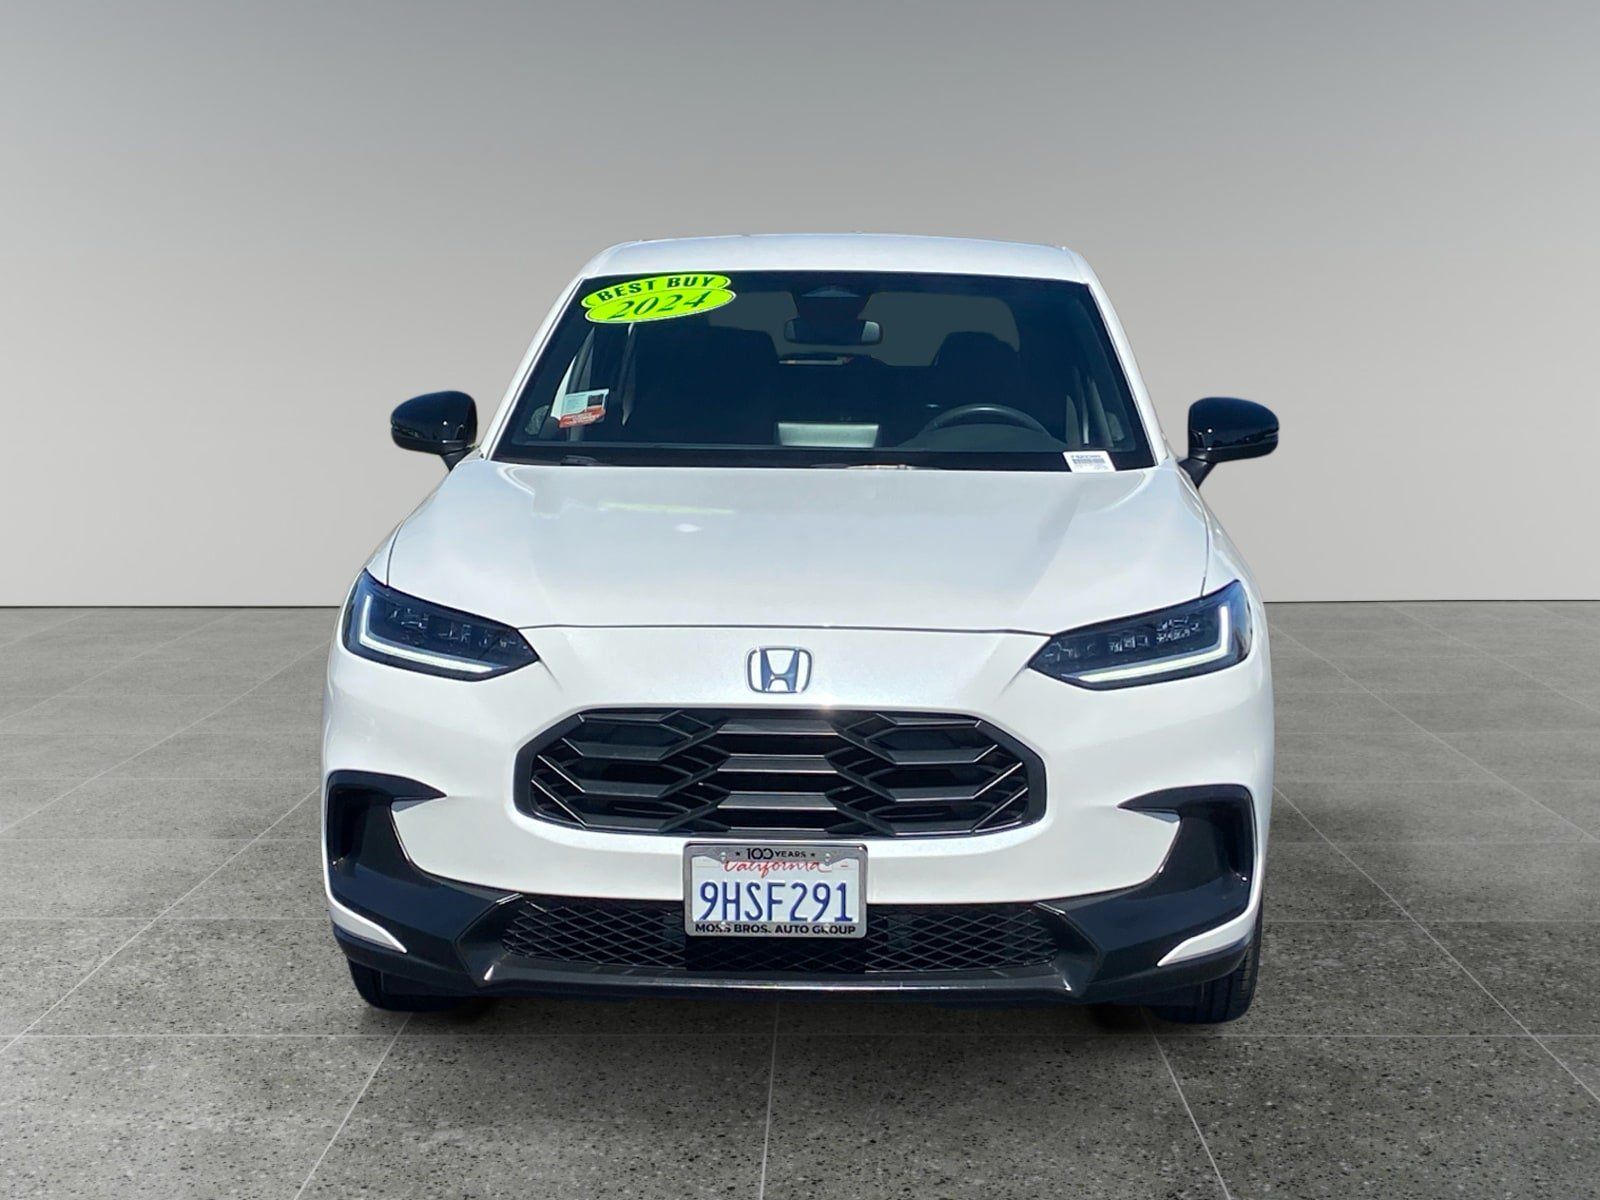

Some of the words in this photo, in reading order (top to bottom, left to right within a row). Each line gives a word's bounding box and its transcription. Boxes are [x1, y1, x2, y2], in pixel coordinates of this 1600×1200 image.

[596, 280, 656, 302] BEST
[667, 276, 716, 288] BUY
[607, 291, 712, 319] 2024
[747, 848, 774, 860] 100
[724, 861, 832, 878] California
[698, 881, 853, 921] 9HSF291
[695, 923, 731, 933] MOSS
[734, 923, 771, 934] BROS.
[775, 924, 809, 934] AUTO
